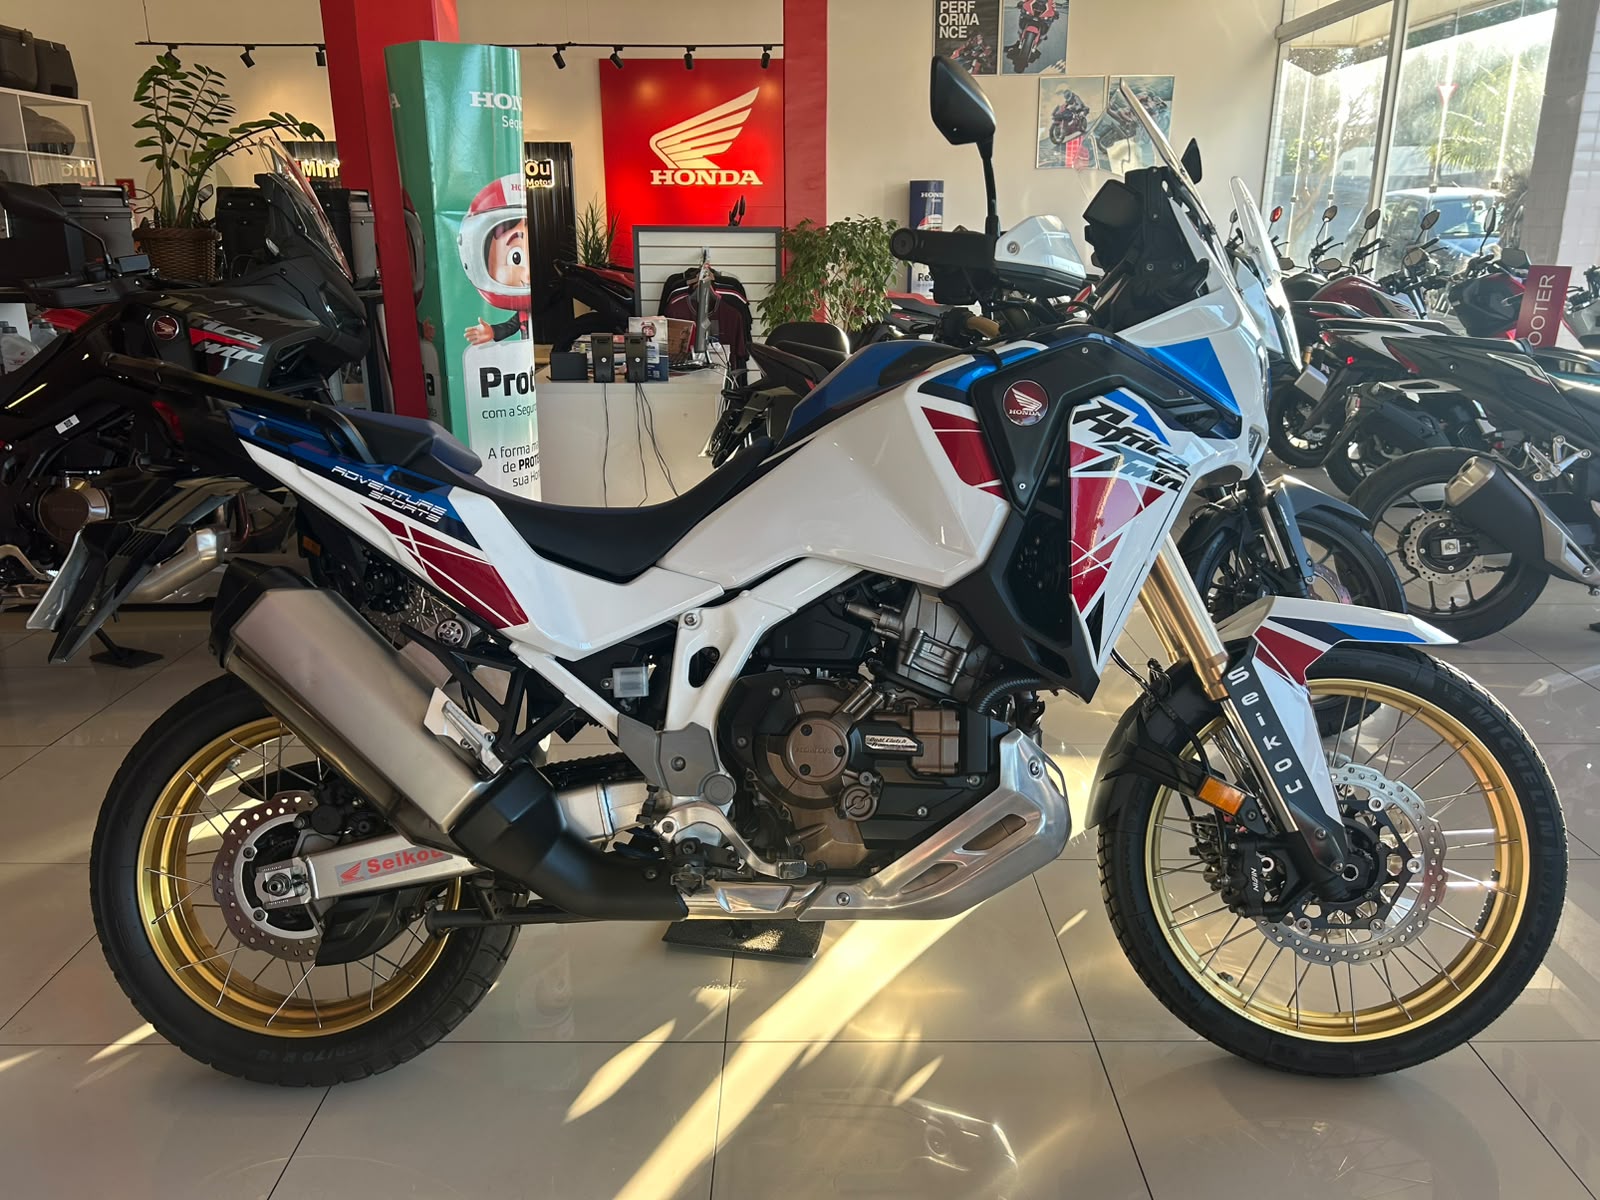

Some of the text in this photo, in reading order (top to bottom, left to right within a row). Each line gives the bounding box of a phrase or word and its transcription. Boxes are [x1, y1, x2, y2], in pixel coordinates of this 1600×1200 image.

[940, 1, 976, 13] PERF
[939, 13, 980, 26] ORMA
[940, 26, 967, 38] NCE
[650, 169, 763, 186] HONDA
[481, 407, 507, 420] com
[509, 407, 516, 417] a
[1008, 408, 1042, 418] HONDA
[488, 447, 497, 460] A
[500, 443, 531, 459] forma
[502, 462, 516, 474] de
[512, 474, 529, 488] sua
[331, 465, 447, 516] ADVENTURE
[368, 489, 441, 523] SPORTS
